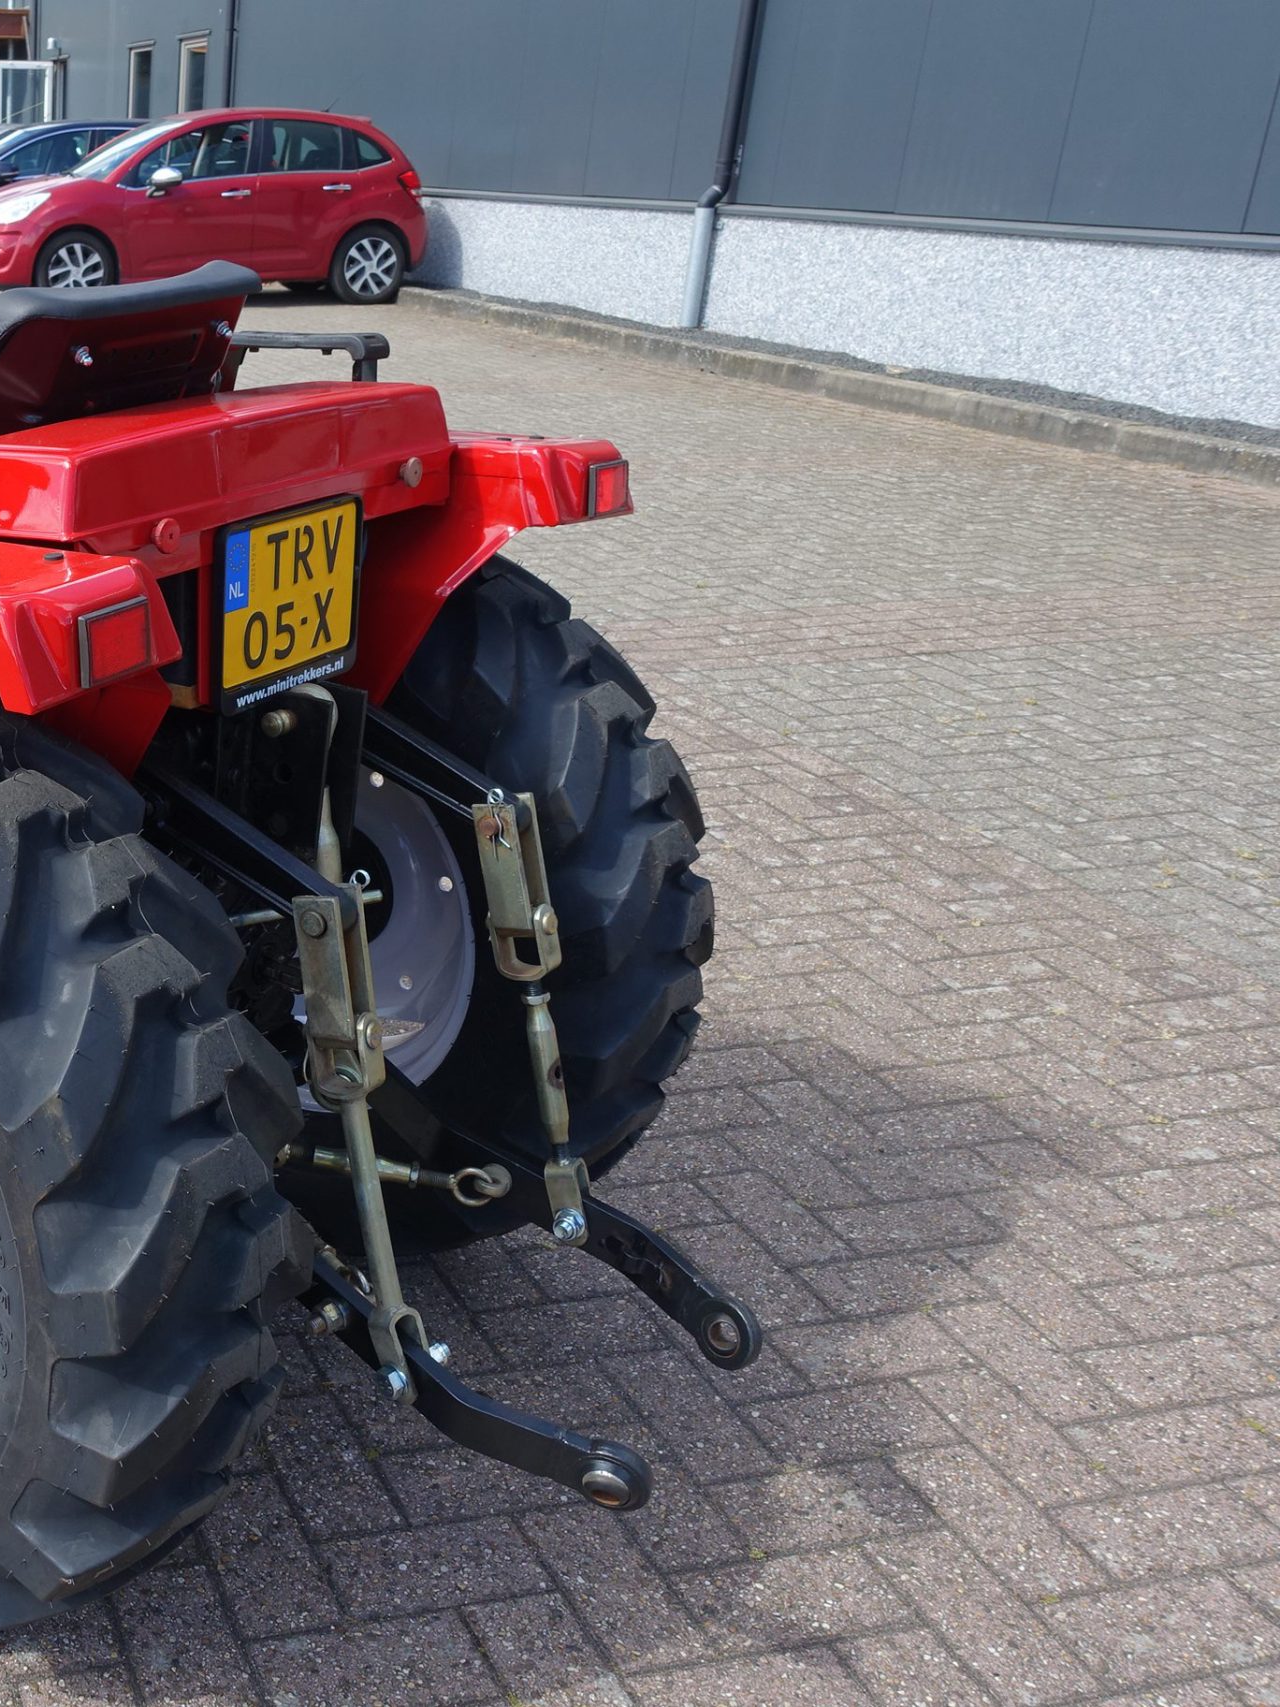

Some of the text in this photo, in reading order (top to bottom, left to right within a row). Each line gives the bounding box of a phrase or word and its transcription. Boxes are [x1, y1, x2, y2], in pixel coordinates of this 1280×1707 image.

[267, 515, 344, 591] TRV
[228, 581, 245, 601] NL
[243, 588, 334, 670] 05-X
[236, 656, 344, 708] www.minitrekkers.nl
